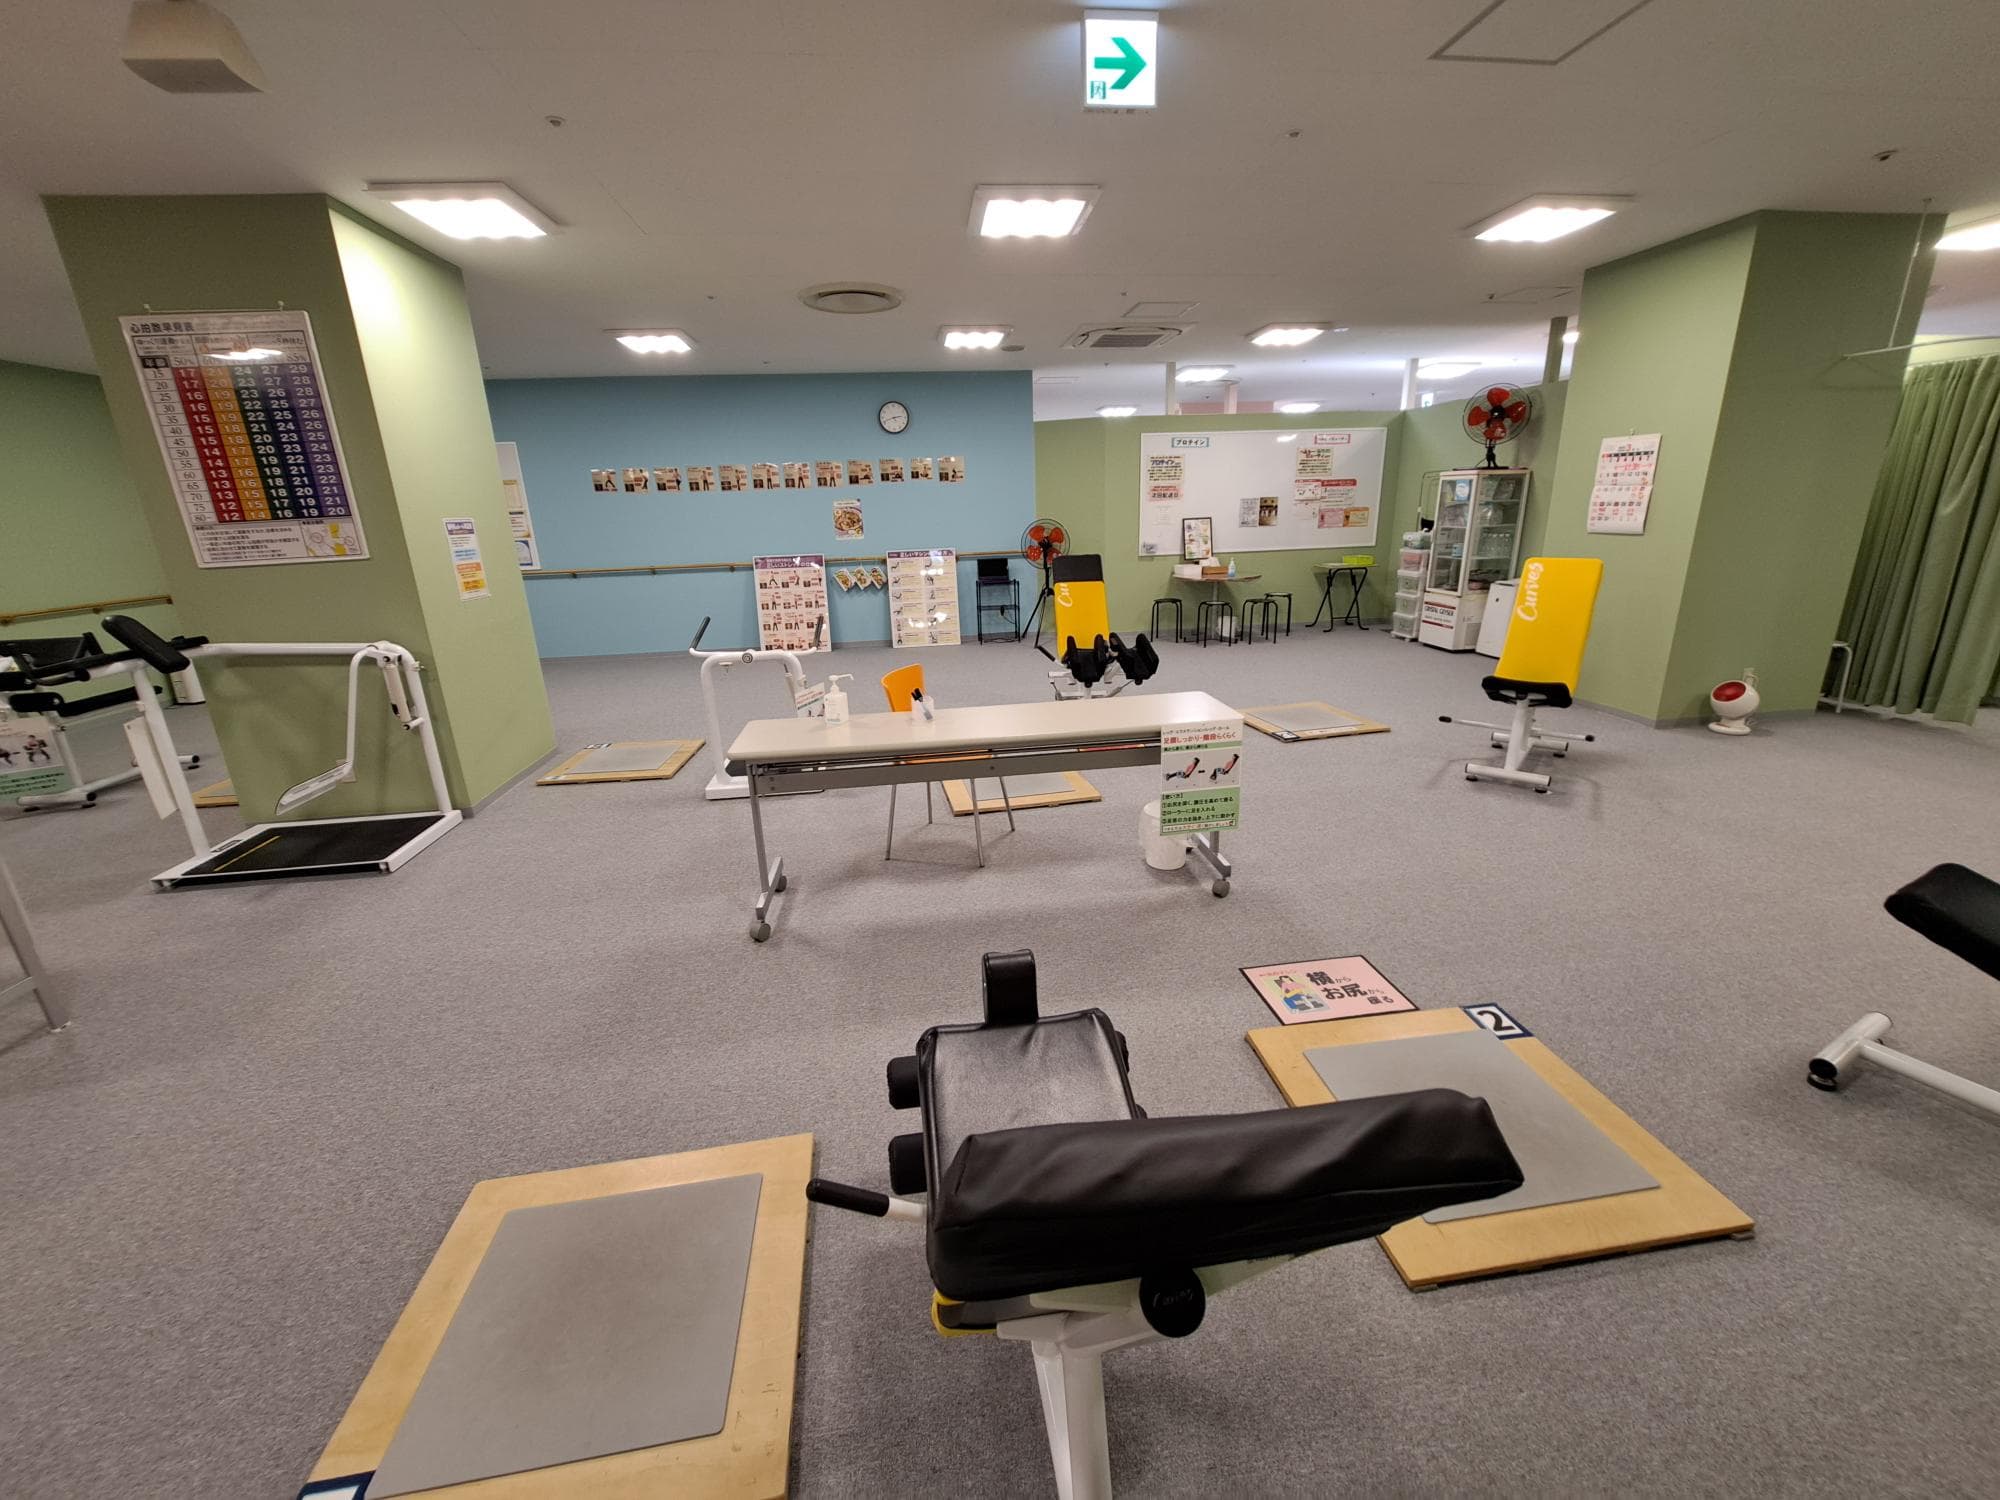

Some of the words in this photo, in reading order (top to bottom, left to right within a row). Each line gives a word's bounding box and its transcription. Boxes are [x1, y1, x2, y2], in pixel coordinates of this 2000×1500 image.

[179, 368, 197, 377] 17
[235, 366, 252, 375] 24
[262, 365, 279, 374] 27
[290, 364, 308, 374] 29
[183, 380, 200, 389] 17
[238, 378, 255, 387] 23
[265, 377, 282, 386] 27
[293, 376, 310, 385] 28
[186, 391, 204, 400] 16
[242, 389, 259, 398] 23
[268, 388, 285, 397] 26
[296, 387, 313, 396] 28
[190, 403, 207, 412] 16
[245, 400, 262, 410] 22
[271, 399, 288, 409] 25
[299, 398, 316, 408] 27
[193, 414, 211, 423] 15
[248, 412, 265, 421] 22
[274, 411, 291, 420] 25
[302, 410, 319, 419] 26
[197, 425, 214, 435] 15
[251, 423, 268, 432] 21
[277, 422, 295, 431] 24
[305, 421, 322, 430] 26
[200, 436, 217, 446] 15
[255, 434, 272, 443] 20
[280, 433, 298, 442] 23
[308, 432, 325, 441] 25
[204, 448, 221, 457] 14
[258, 445, 275, 454] 20
[283, 444, 301, 453] 23
[311, 443, 328, 452] 24
[207, 459, 224, 468] 14
[261, 456, 278, 465] 19
[287, 455, 304, 464] 22
[314, 454, 331, 463] 23
[210, 469, 228, 479] 13
[264, 467, 281, 476] 19
[290, 466, 307, 475] 21
[317, 464, 334, 474] 23
[214, 480, 231, 489] 13
[267, 478, 284, 487] 18
[293, 476, 310, 486] 21
[320, 475, 337, 484] 22
[217, 491, 234, 500] 13
[270, 488, 287, 497] 18
[296, 487, 313, 496] 20
[323, 486, 340, 495] 21
[220, 501, 238, 511] 12
[273, 499, 291, 508] 17
[299, 498, 316, 507] 19
[326, 496, 343, 505] 21
[224, 512, 241, 521] 12
[276, 509, 294, 518] 16
[302, 508, 319, 517] 19
[329, 506, 346, 516] 20
[1517, 562, 1544, 622] Curves
[1305, 971, 1352, 986] 横から
[1321, 983, 1385, 1000] お尻から
[1477, 1010, 1516, 1032] 2
